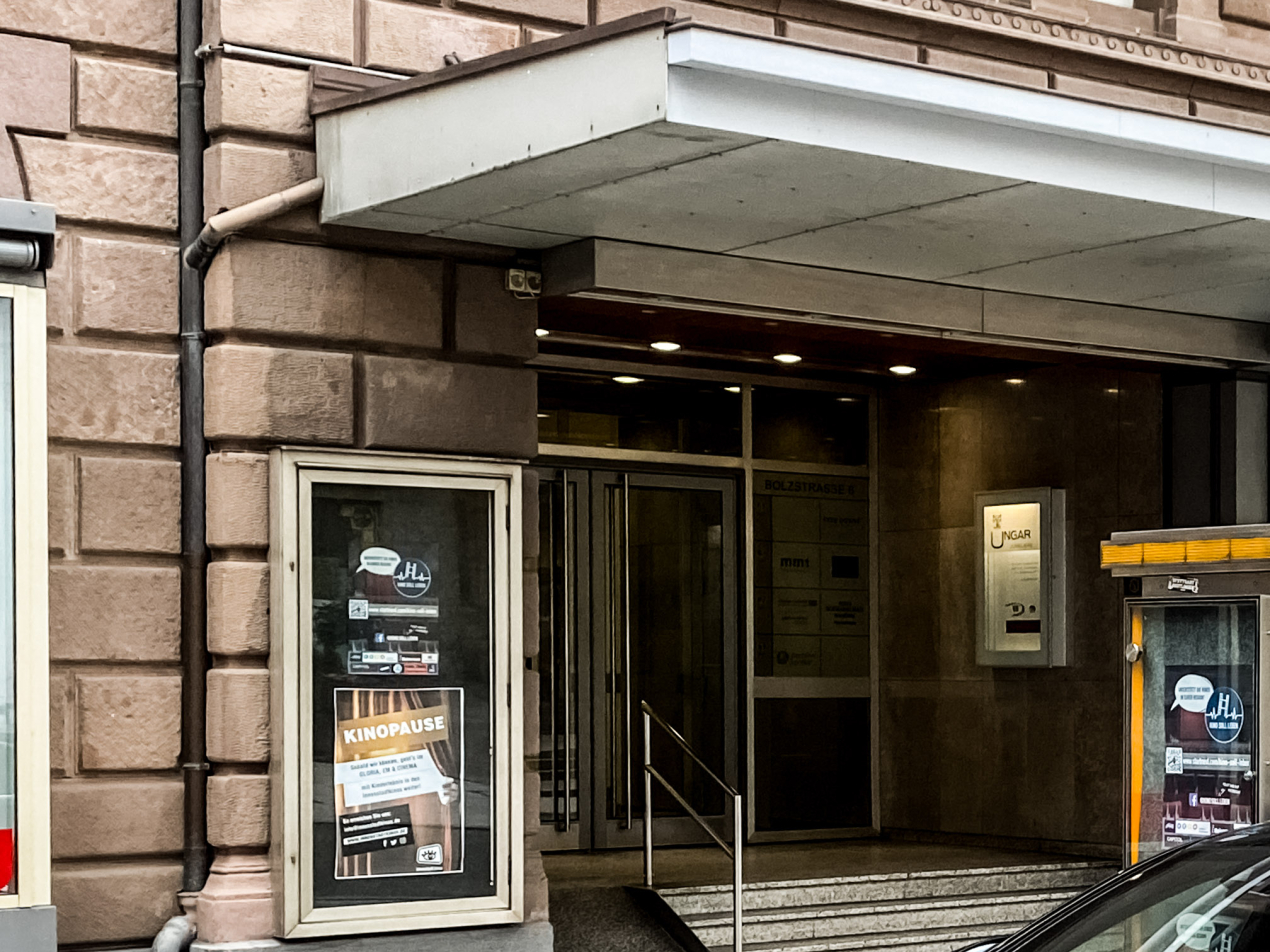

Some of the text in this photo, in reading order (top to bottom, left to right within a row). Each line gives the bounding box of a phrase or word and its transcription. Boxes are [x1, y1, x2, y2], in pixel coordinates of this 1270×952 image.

[765, 480, 845, 495] BOLZSTRASSE
[990, 529, 1032, 549] UNGAR
[343, 716, 445, 744] KINOPAUSE
